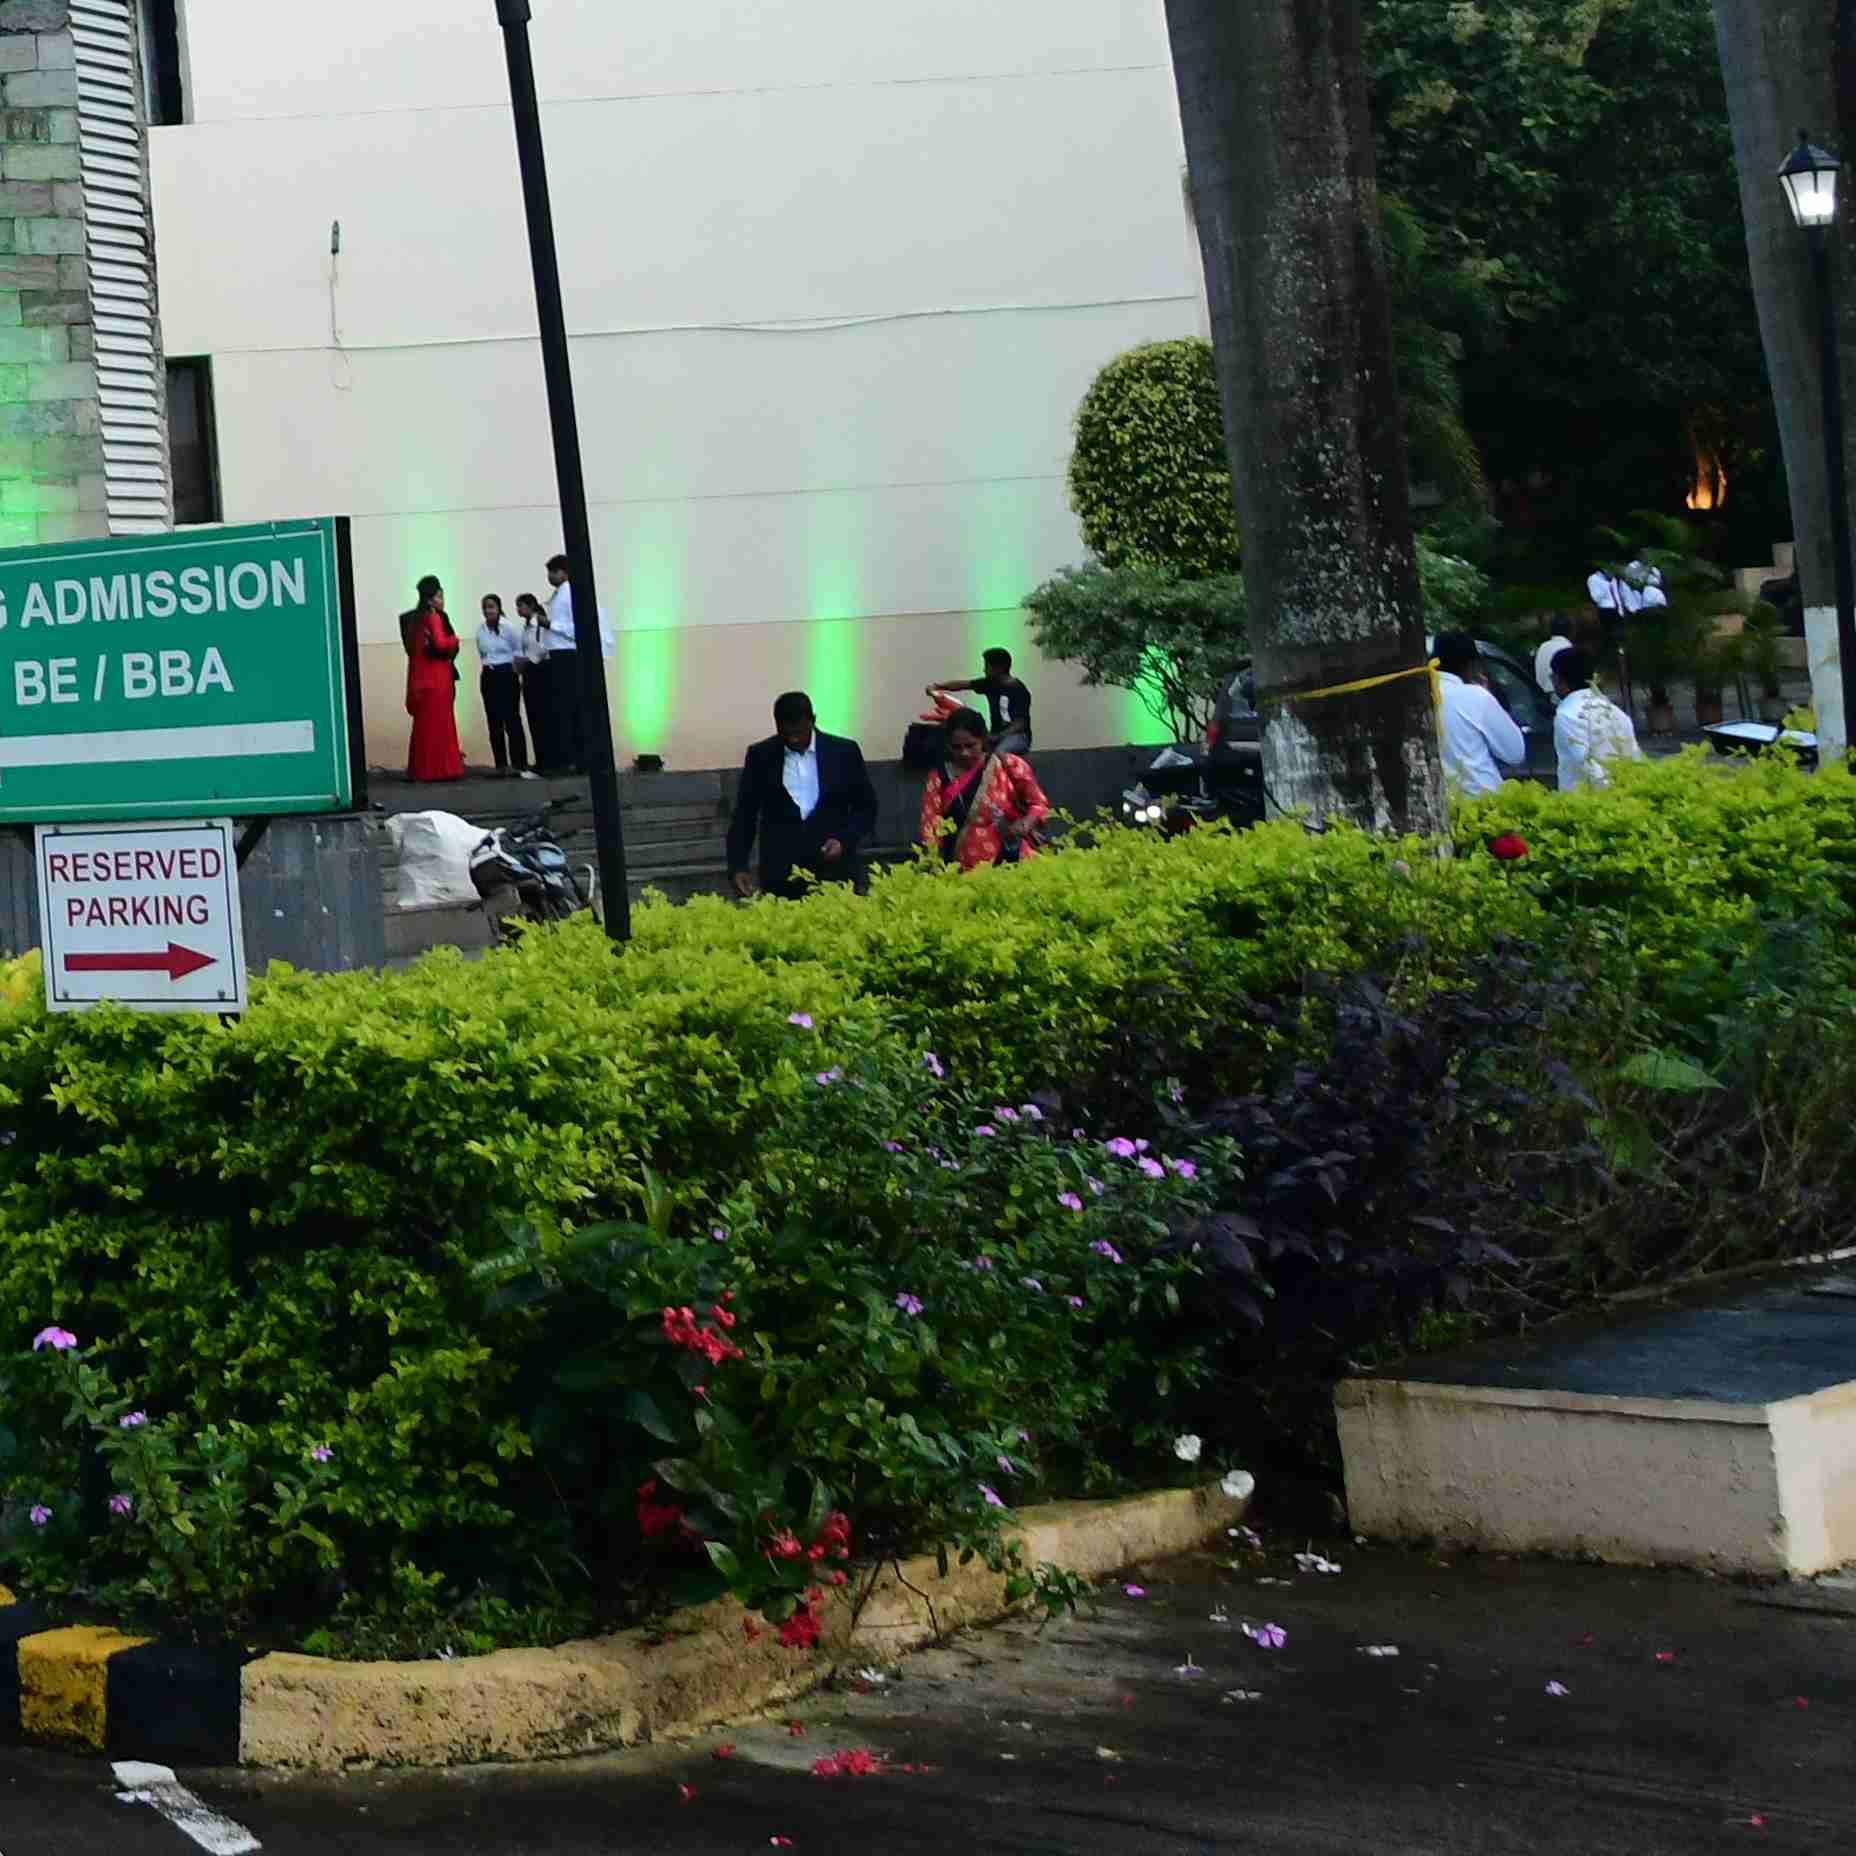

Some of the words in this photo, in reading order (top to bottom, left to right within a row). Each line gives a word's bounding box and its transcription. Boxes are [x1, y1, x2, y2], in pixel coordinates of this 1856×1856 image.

[20, 557, 307, 629] ADMISSION
[13, 656, 80, 706] BE
[93, 654, 107, 702] /
[121, 646, 235, 700] BBA
[48, 847, 222, 883] RESERVED
[66, 894, 210, 928] PARKING
